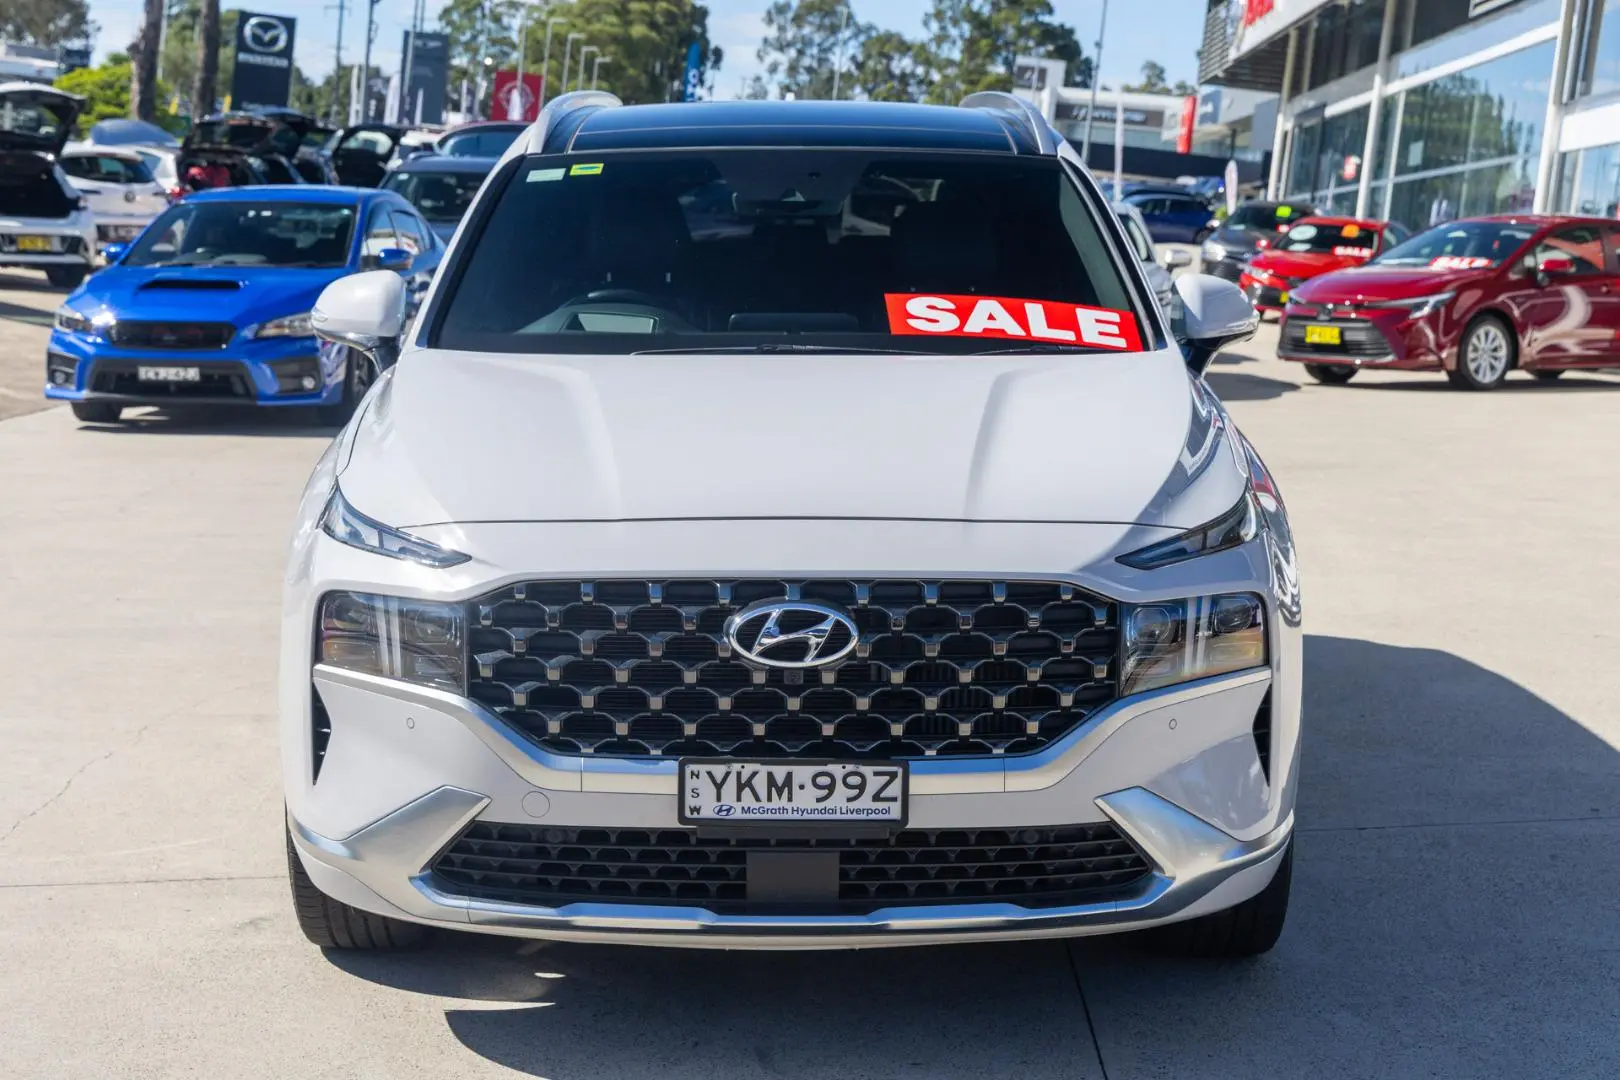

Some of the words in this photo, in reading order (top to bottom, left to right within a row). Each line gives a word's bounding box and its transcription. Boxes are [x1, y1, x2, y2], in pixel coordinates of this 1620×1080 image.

[905, 296, 1128, 348] SALE
[741, 805, 789, 815] McGrath
[791, 805, 838, 817] Hyundai
[839, 805, 891, 817] Liverpool
